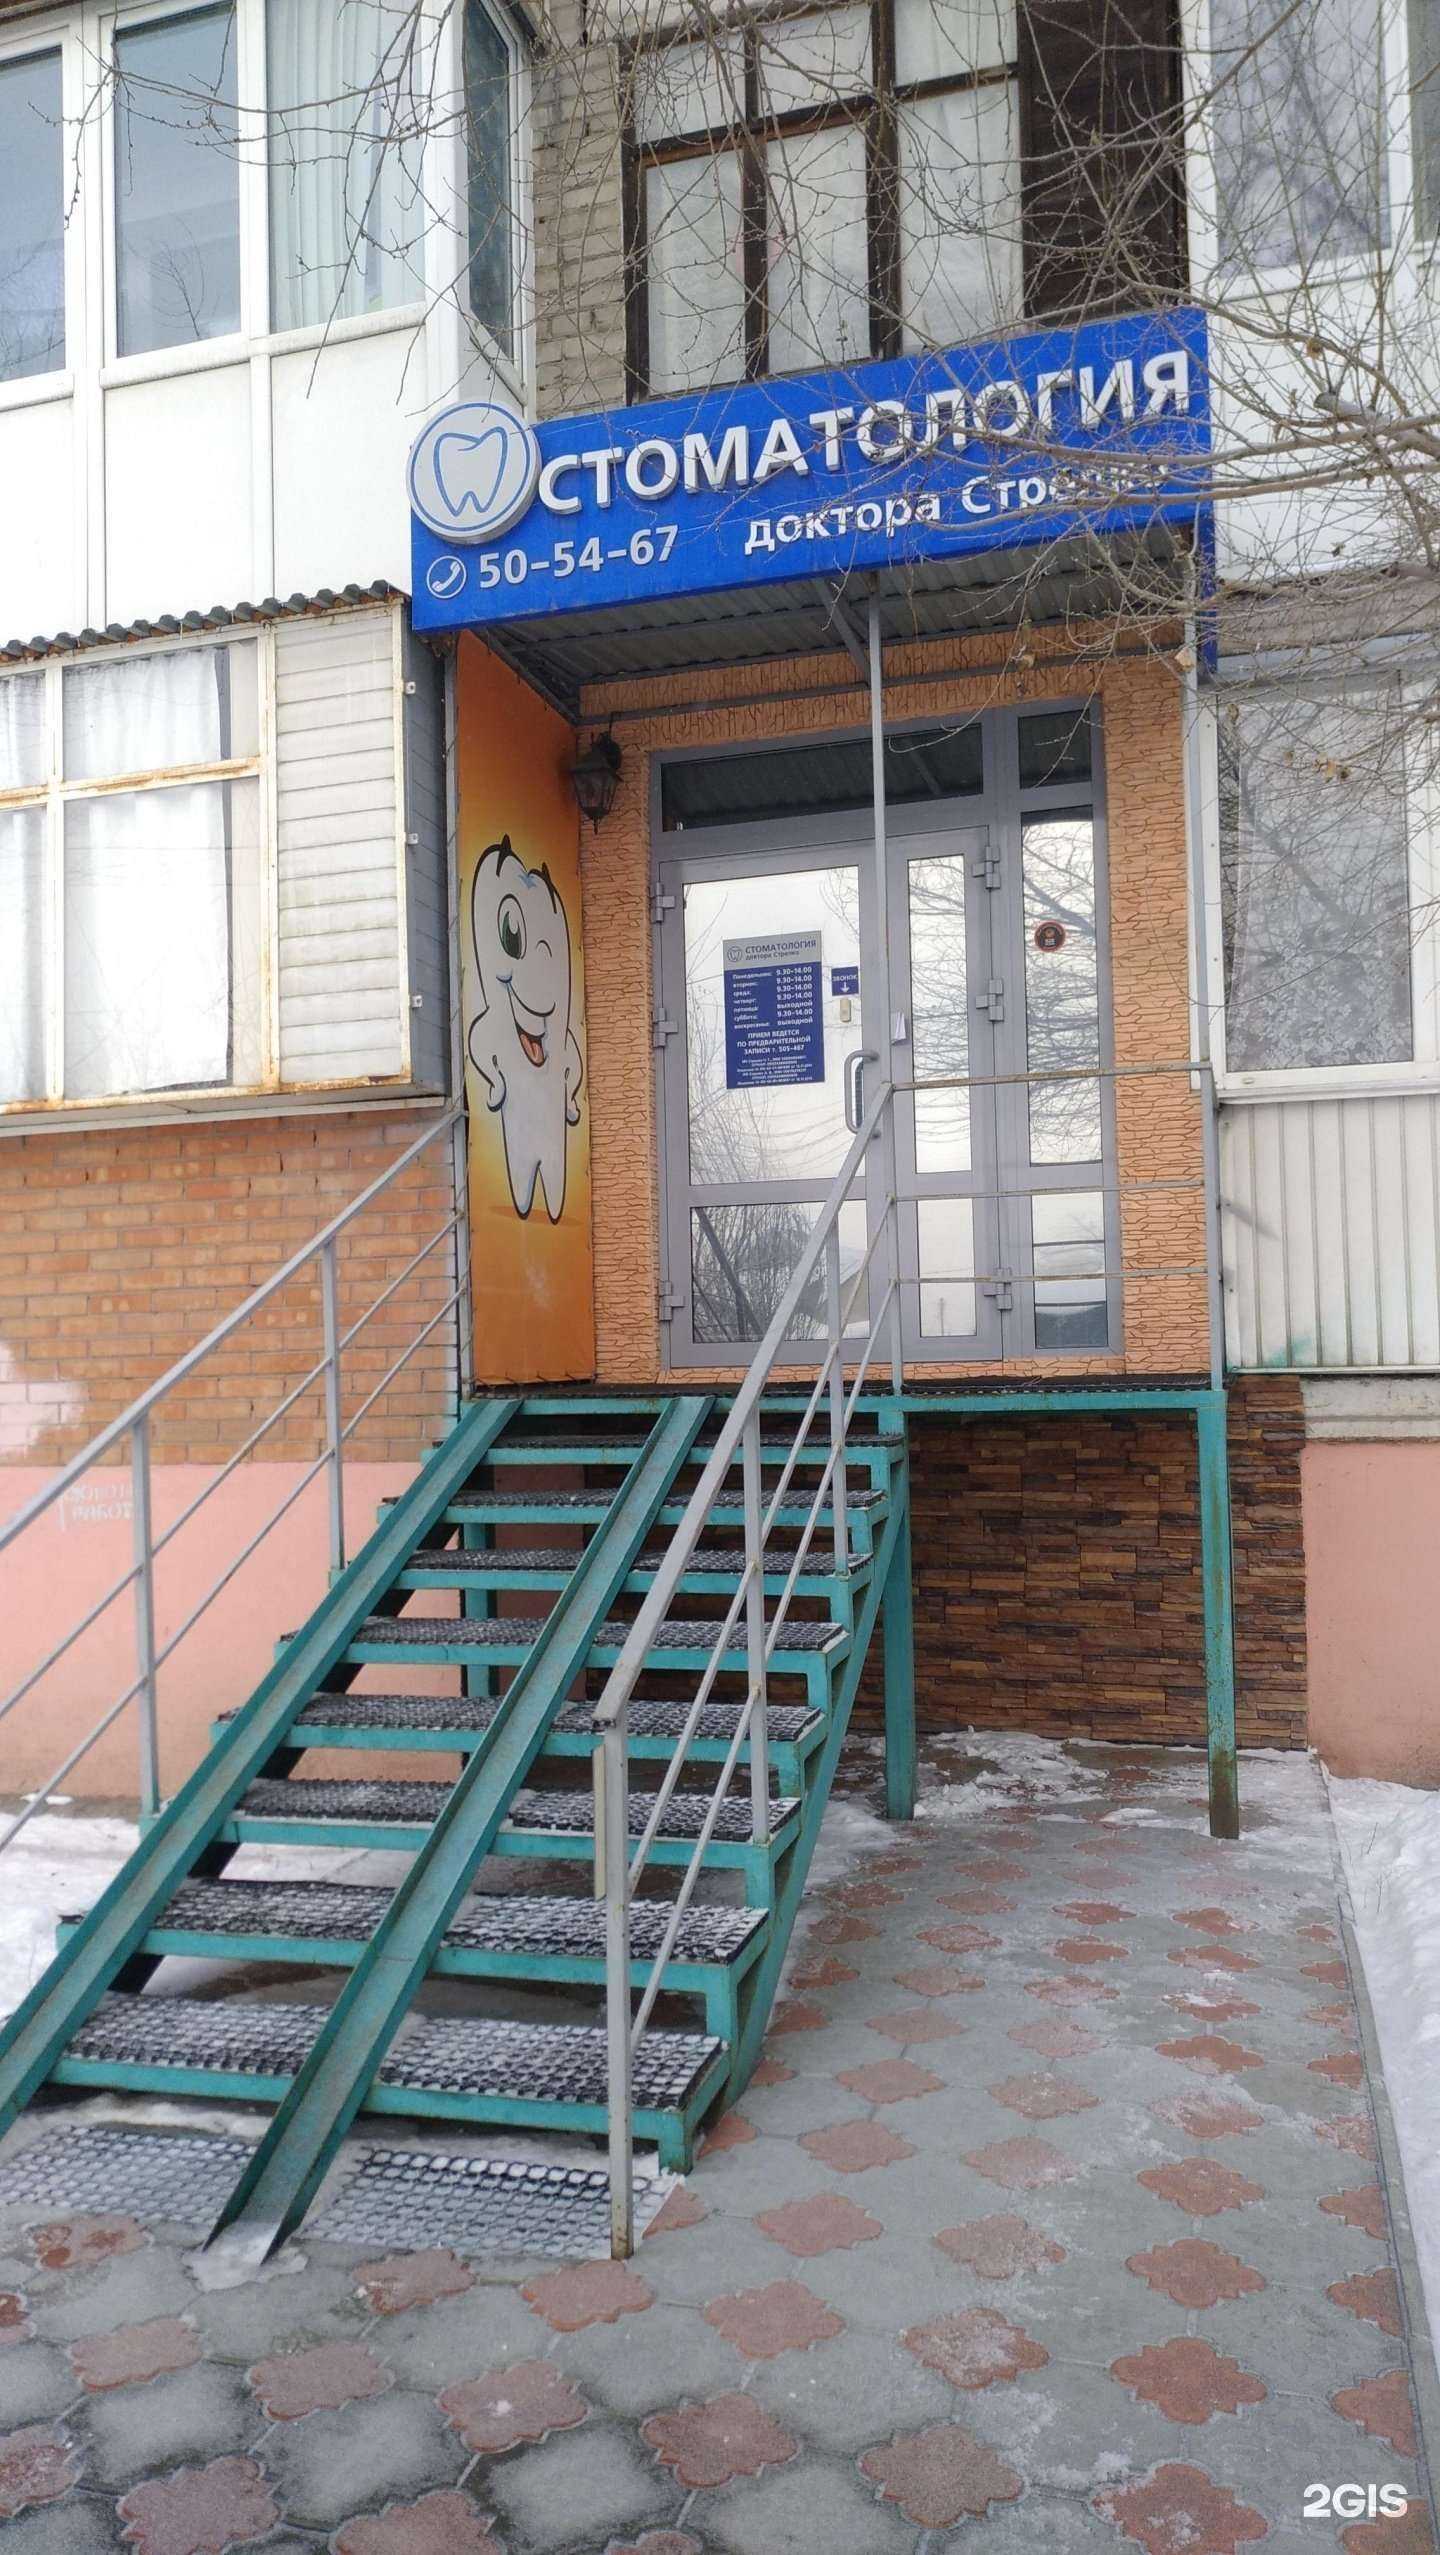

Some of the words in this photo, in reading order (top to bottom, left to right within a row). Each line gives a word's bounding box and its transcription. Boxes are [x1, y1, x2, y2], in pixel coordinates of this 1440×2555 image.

[538, 350, 1189, 515] СТОМАТОЛОГИЯ
[744, 493, 941, 555] доктора
[479, 524, 678, 588] 50-54-67
[745, 939, 816, 954] СТОМАТОЛОГИЯ
[832, 974, 857, 982] ЗВОНОК
[748, 1035, 811, 1047] ПРЕДВАРИТЕЛЬНОЙ
[744, 1047, 770, 1055] ЗАПИСИ
